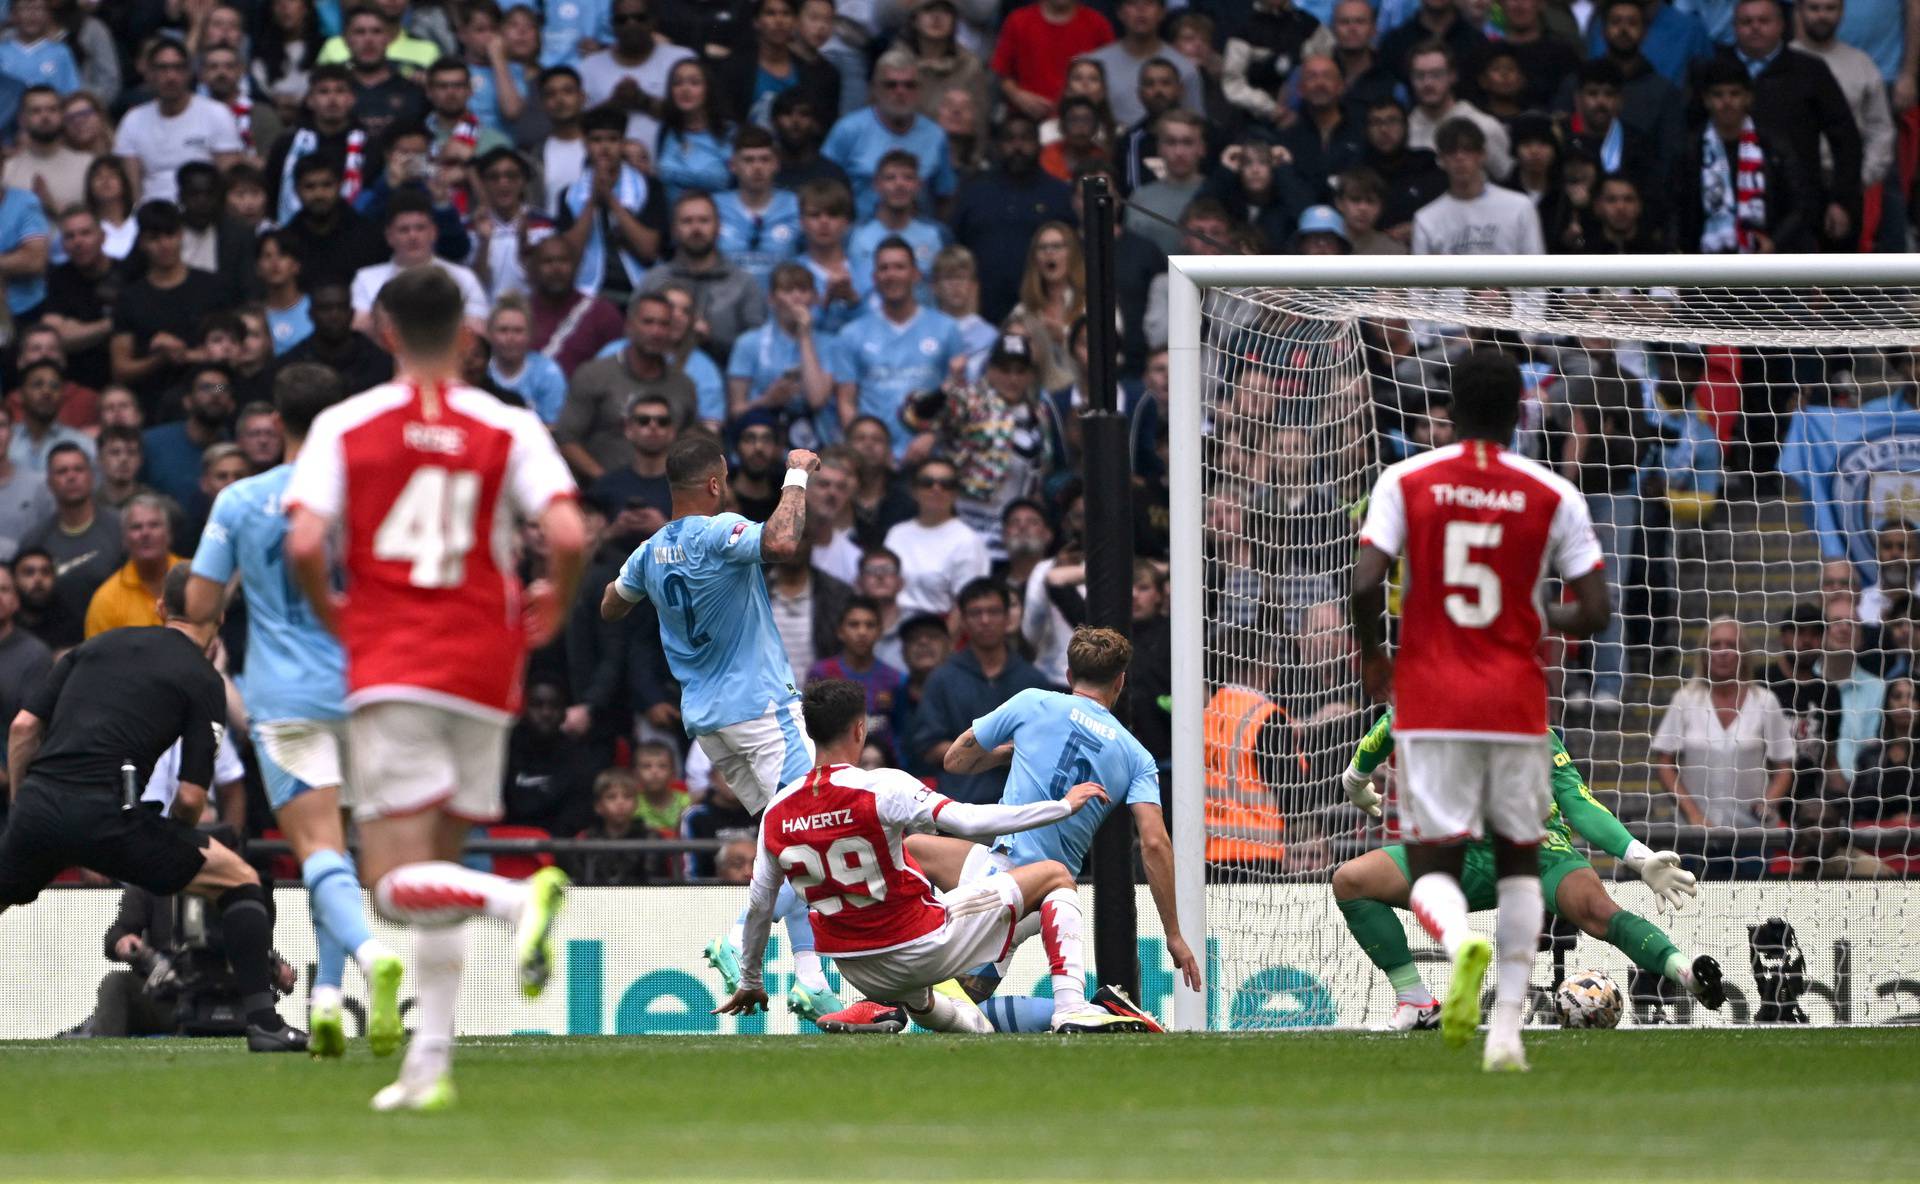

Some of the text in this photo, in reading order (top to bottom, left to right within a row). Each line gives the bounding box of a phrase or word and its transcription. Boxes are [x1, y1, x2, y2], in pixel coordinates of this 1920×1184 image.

[372, 464, 483, 588] 41
[1429, 483, 1527, 513] THOMAS
[663, 572, 712, 649] 2
[1443, 519, 1503, 630] 5
[1069, 707, 1117, 741] STONES
[1049, 729, 1105, 801] 5
[781, 808, 854, 834] HAVERTZ
[777, 835, 889, 917] 29
